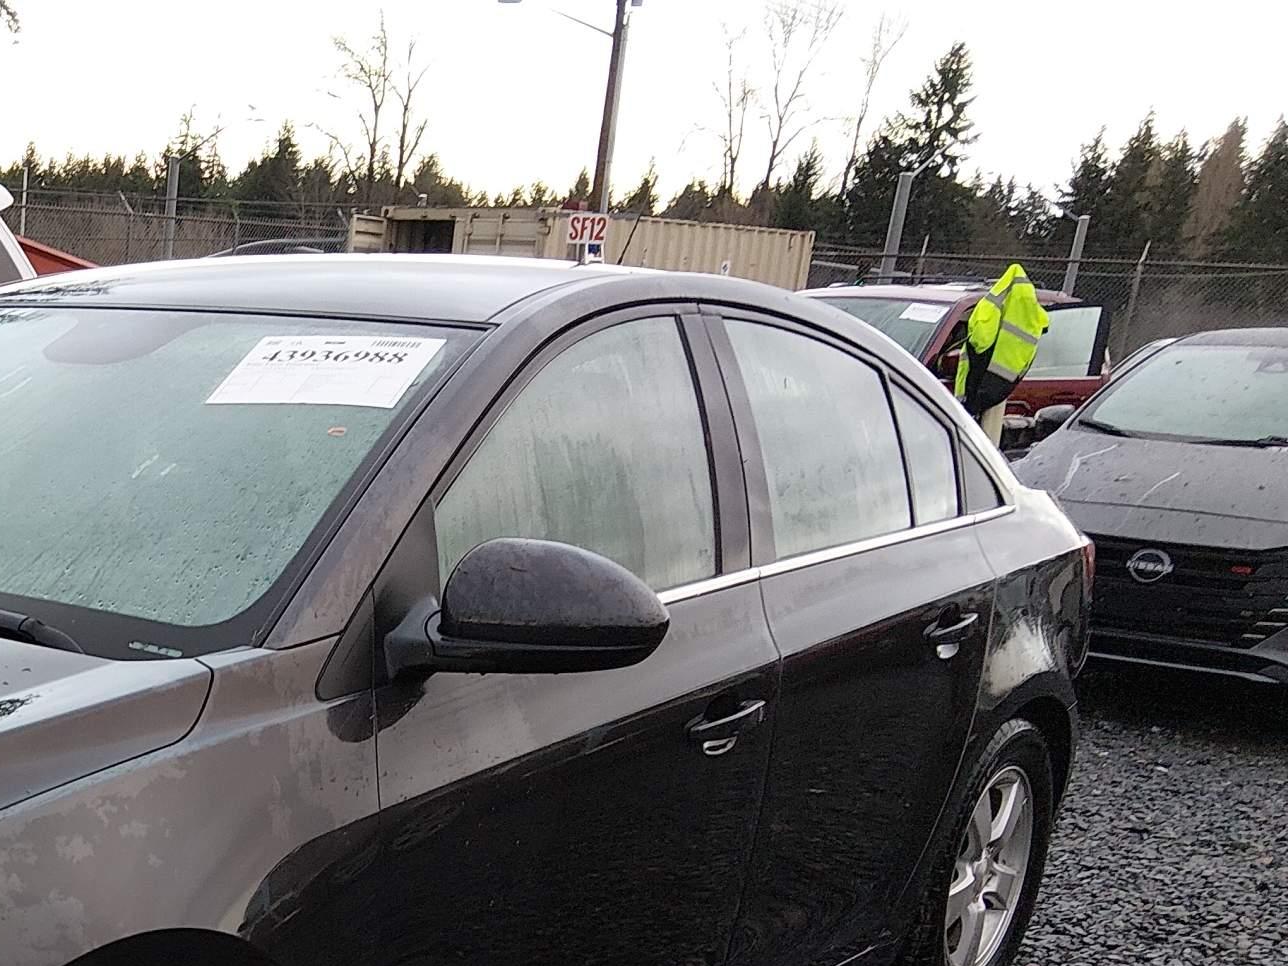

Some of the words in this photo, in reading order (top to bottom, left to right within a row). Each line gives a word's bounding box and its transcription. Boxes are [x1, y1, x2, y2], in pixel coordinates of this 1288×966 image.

[569, 216, 607, 241] SF12
[262, 348, 409, 365] 43936988
[1125, 559, 1175, 573] NISSAN
